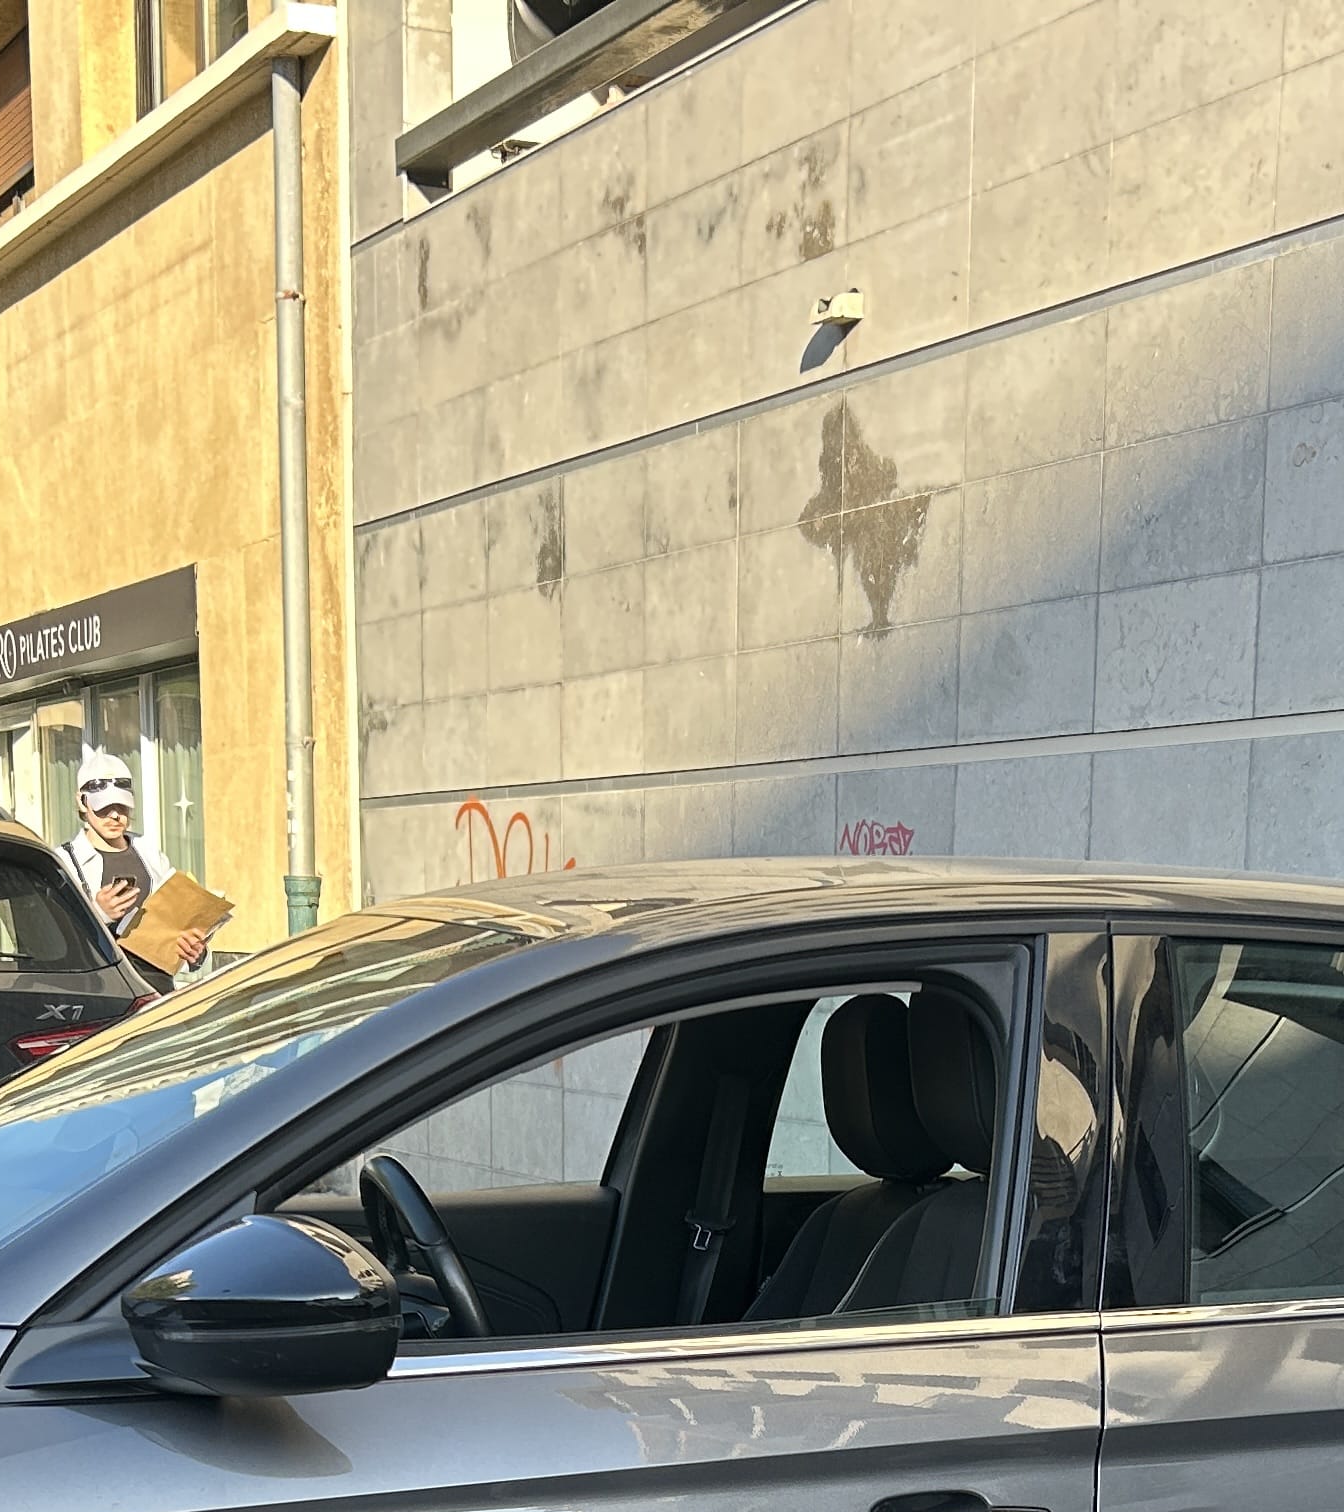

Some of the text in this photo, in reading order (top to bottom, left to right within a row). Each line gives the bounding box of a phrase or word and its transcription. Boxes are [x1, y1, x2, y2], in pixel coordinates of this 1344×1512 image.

[19, 623, 65, 666] PILATES
[68, 614, 102, 654] CLUB
[35, 1004, 84, 1020] X1
